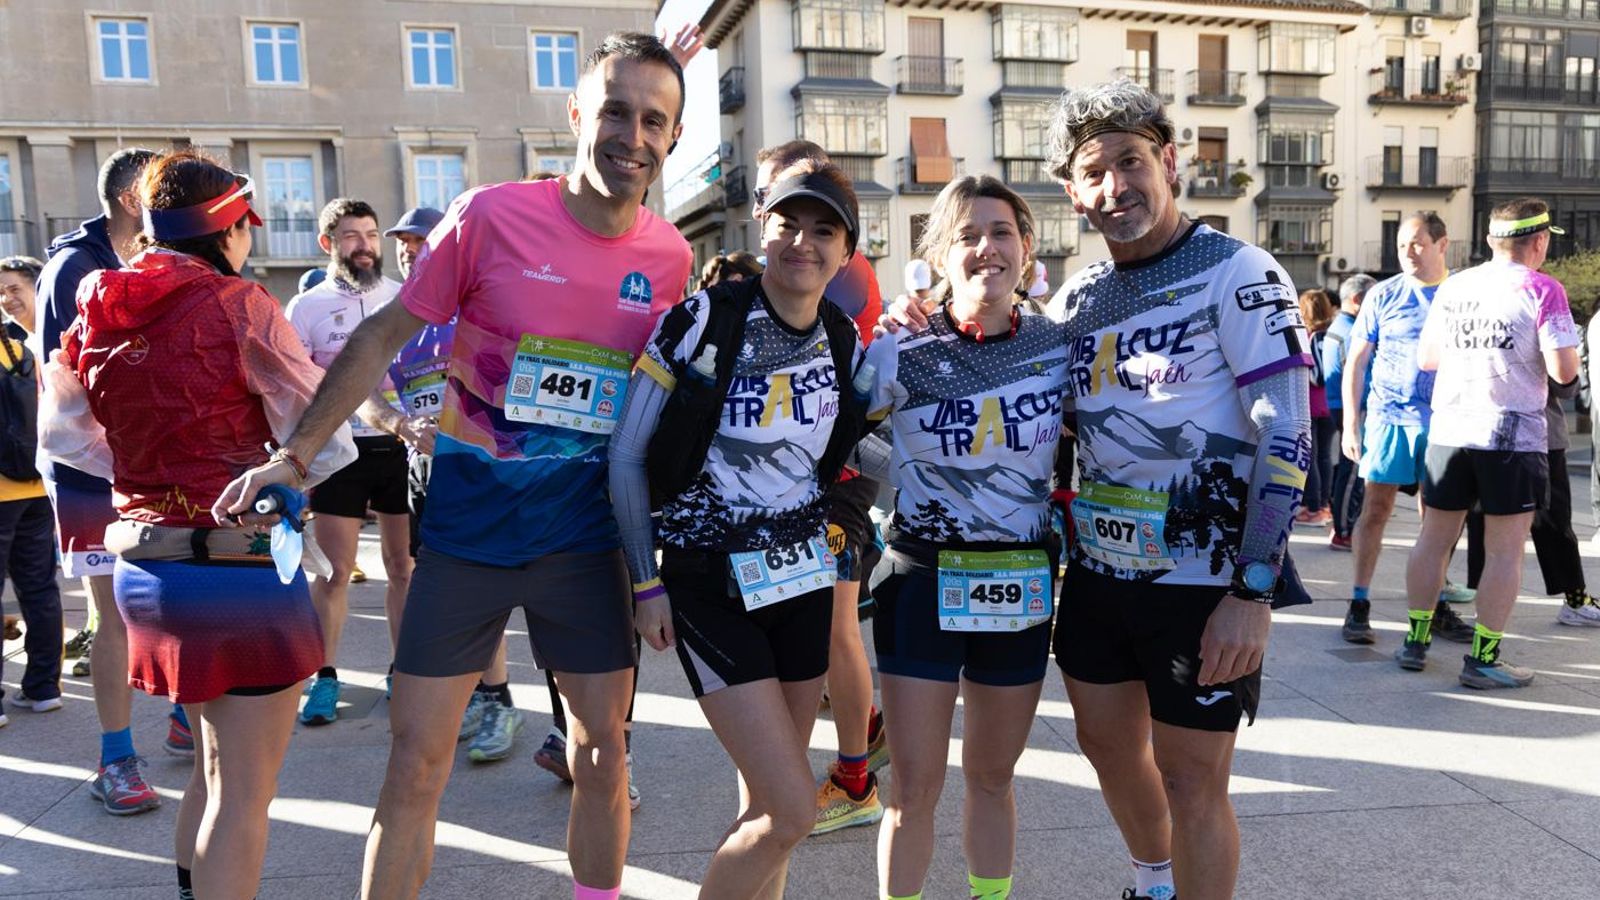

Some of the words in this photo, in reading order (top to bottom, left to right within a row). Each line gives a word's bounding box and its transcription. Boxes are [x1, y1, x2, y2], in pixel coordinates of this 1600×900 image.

[522, 269, 567, 285] TEAMERGY
[540, 372, 592, 400] 481
[1143, 360, 1194, 399] Jaén
[414, 393, 439, 409] 579
[723, 388, 814, 427] TRAIL
[934, 414, 1029, 456] TRAIL
[828, 532, 845, 552] UFF
[1095, 517, 1136, 543] 607
[765, 542, 814, 570] 631
[970, 583, 1022, 604] 459
[825, 803, 852, 819] HOKA
